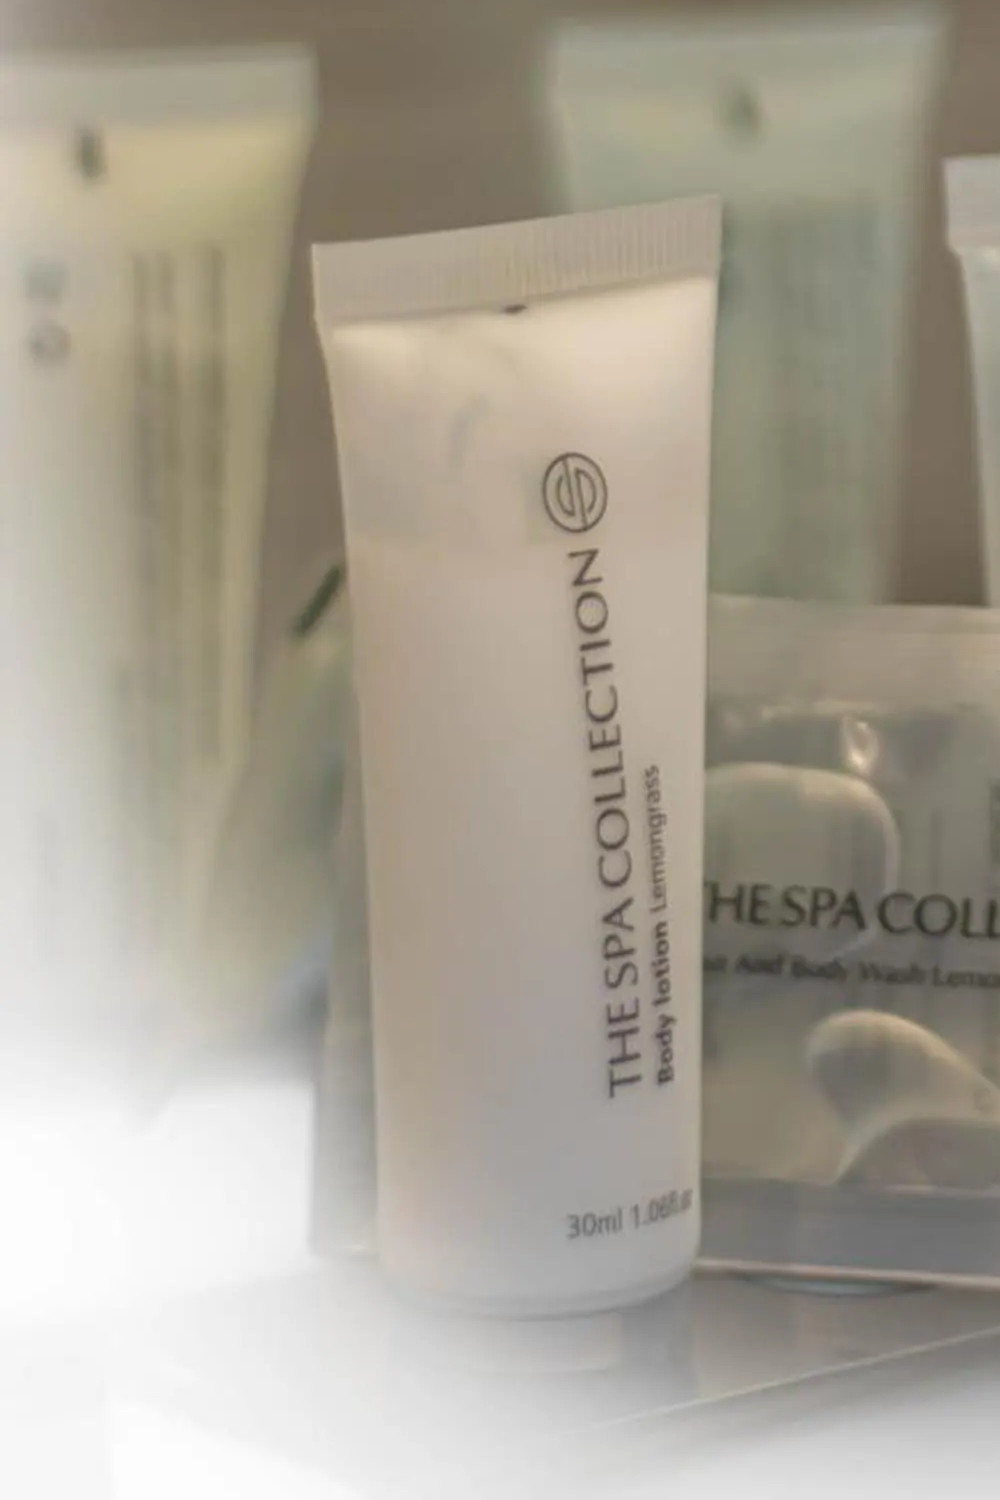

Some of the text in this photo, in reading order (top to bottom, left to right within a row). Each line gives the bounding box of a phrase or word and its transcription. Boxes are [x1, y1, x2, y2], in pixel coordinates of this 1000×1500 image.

[567, 546, 643, 1098] THE SPA COLLECTION
[703, 879, 773, 926] HE
[781, 883, 867, 931] SPA
[640, 764, 676, 1086] Body lotion Lemongrass
[566, 1205, 623, 1240] 30ml
